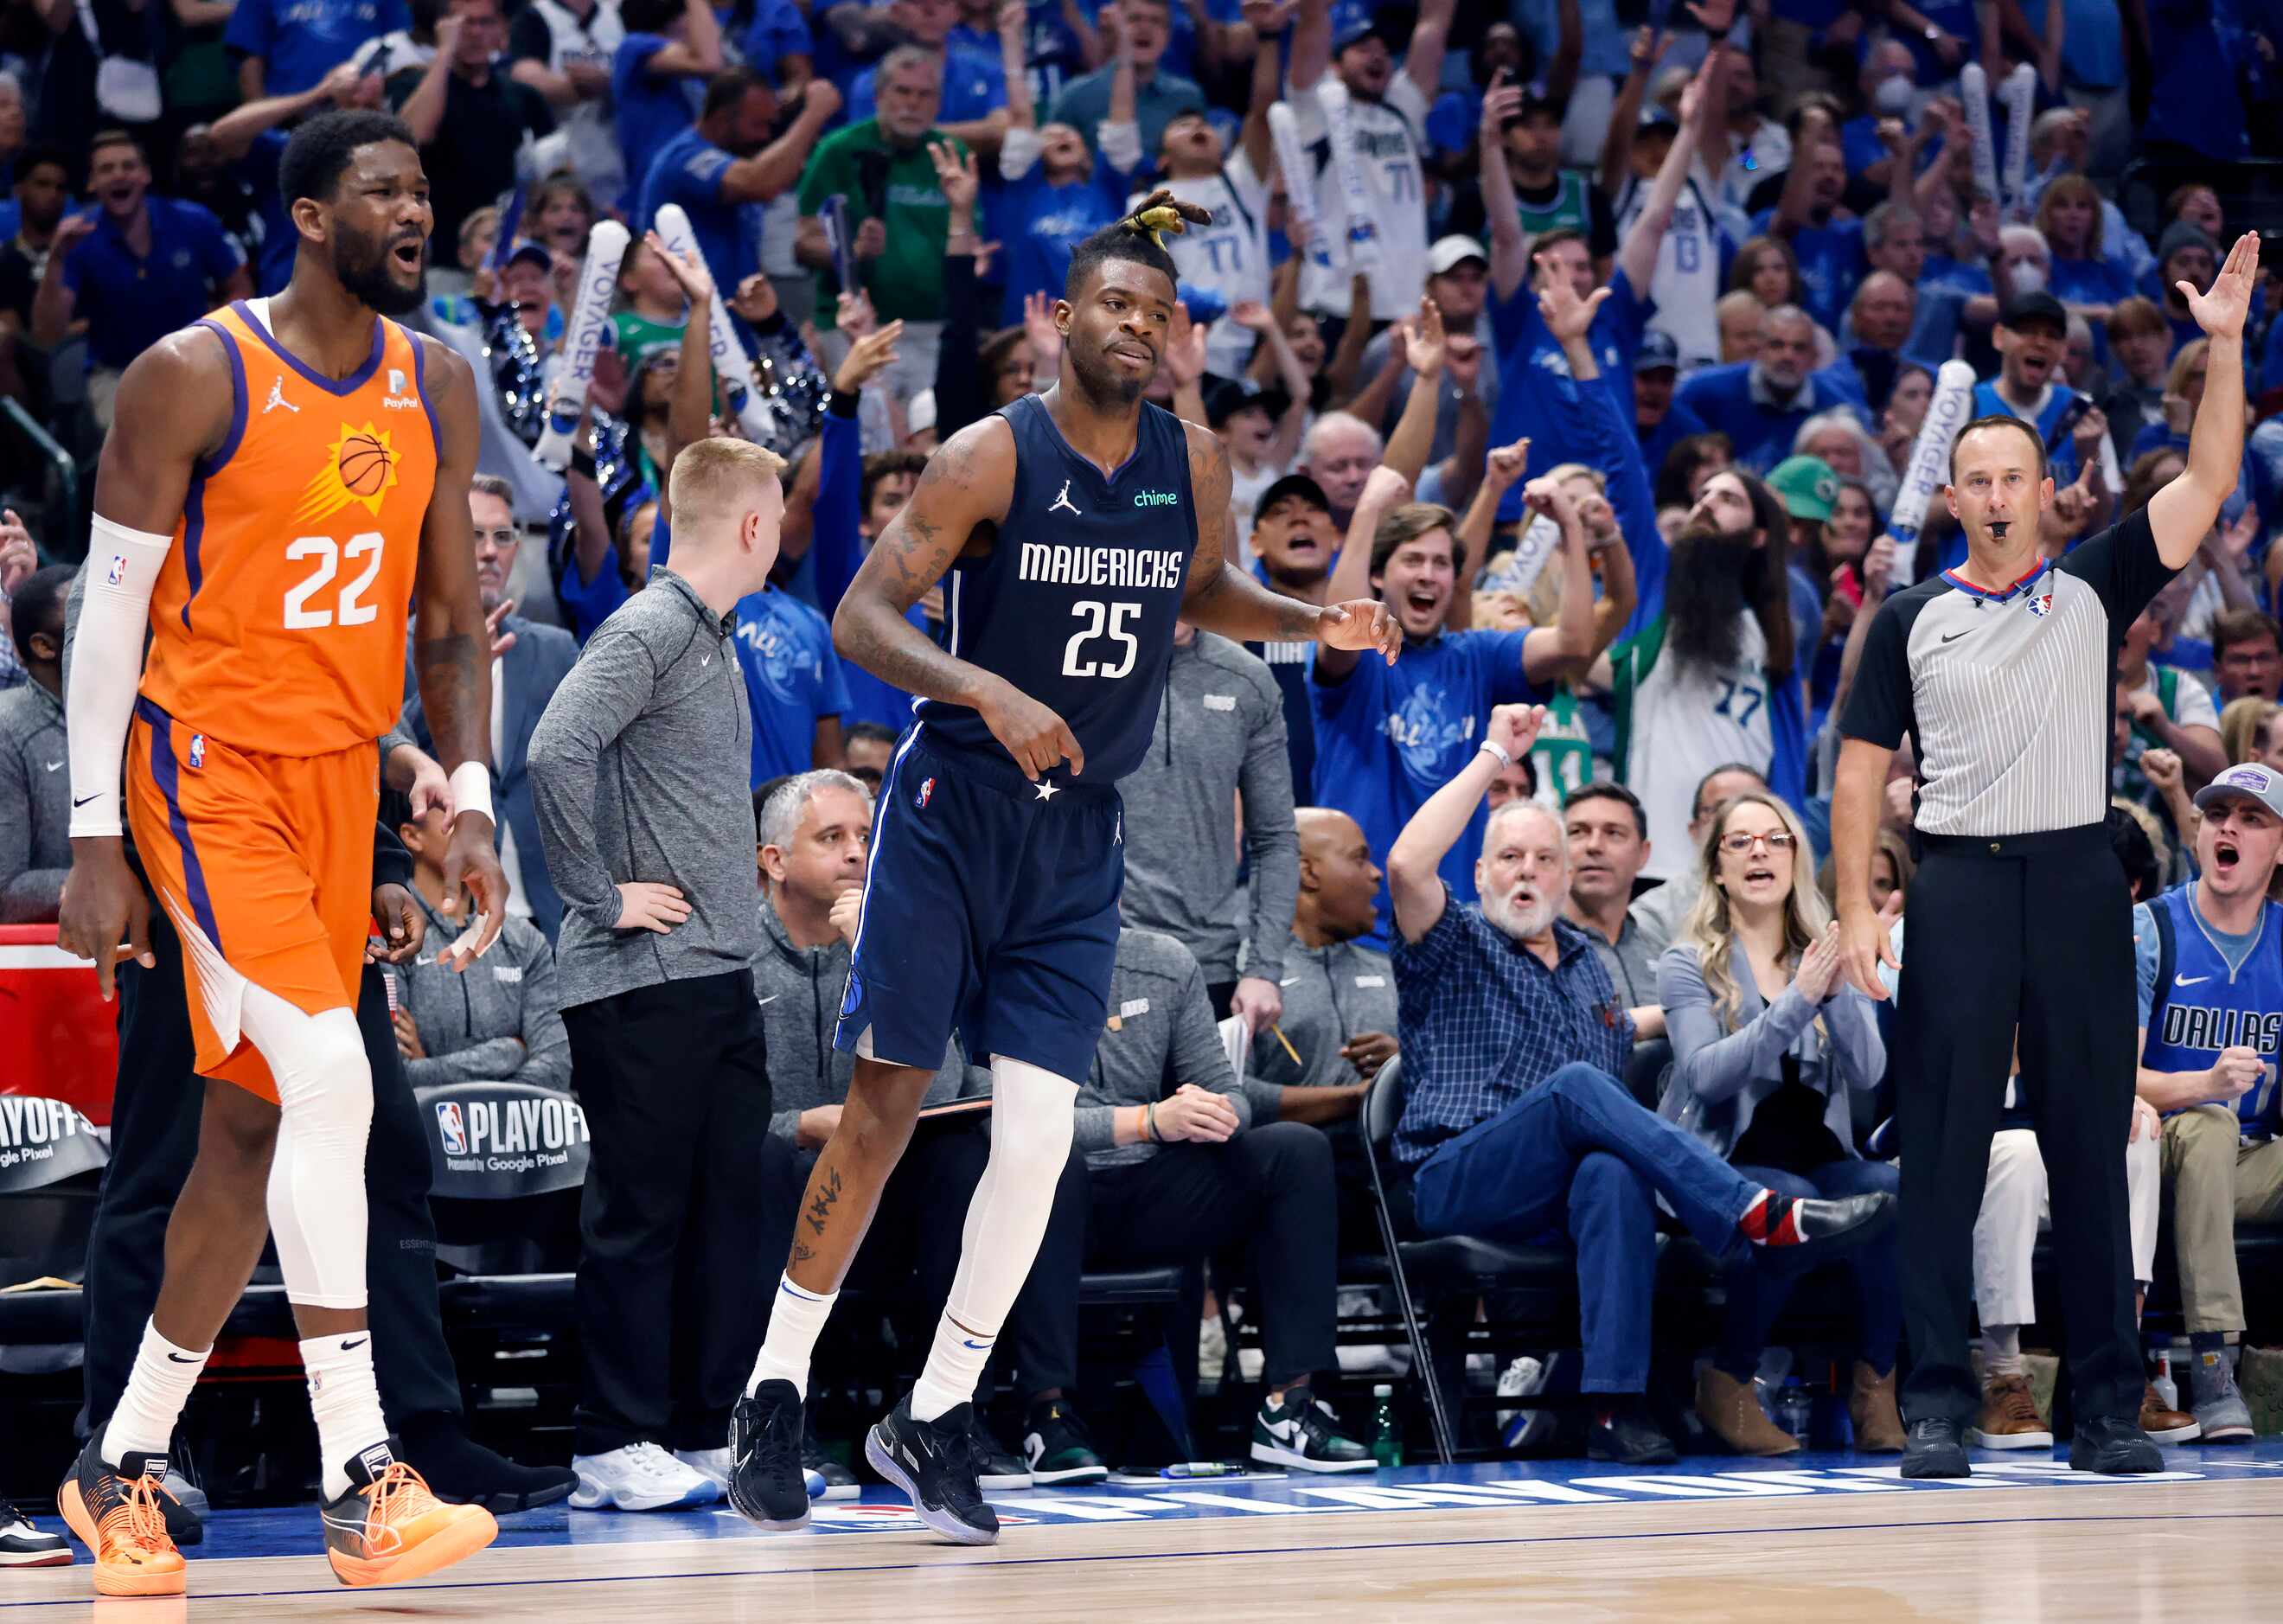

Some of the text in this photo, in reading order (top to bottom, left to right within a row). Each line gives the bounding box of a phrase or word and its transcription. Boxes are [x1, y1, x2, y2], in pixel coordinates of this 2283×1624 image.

[572, 259, 617, 381] VOYAGER
[383, 397, 418, 410] PayPal
[1915, 387, 1965, 496] VOYAGER
[1134, 489, 1178, 507] chime
[284, 531, 385, 629] 22
[1019, 542, 1183, 589] MAVERICKS
[1061, 600, 1142, 679] 25
[2162, 1003, 2283, 1055] DALLAS
[0, 1144, 54, 1167] gle Pixel
[487, 1154, 534, 1173] Google
[536, 1150, 568, 1167] Pixel
